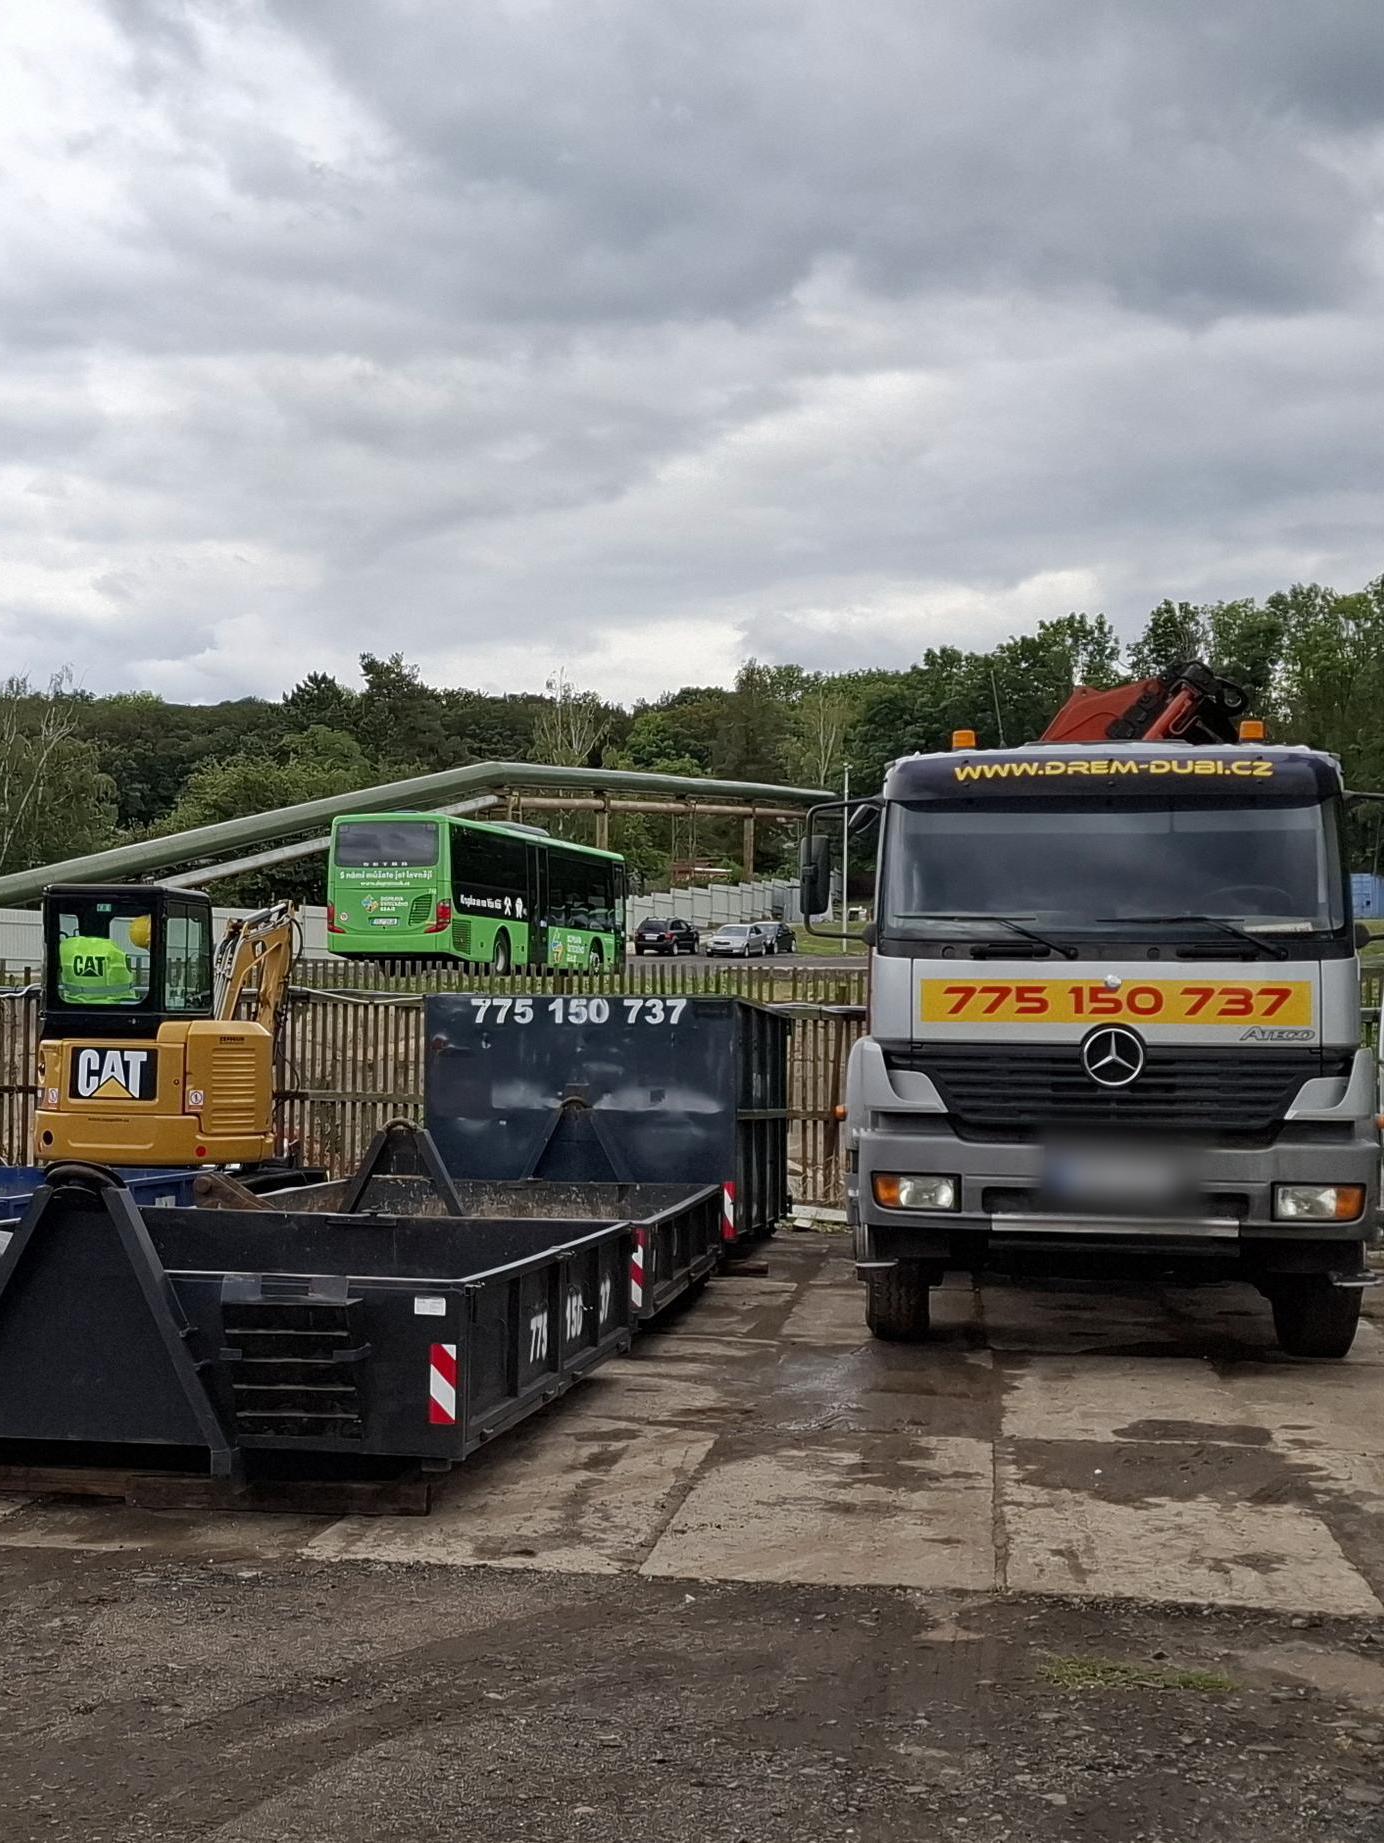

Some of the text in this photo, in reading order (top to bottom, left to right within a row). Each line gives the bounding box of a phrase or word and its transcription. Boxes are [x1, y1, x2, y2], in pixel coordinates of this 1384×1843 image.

[954, 760, 1274, 781] WWW.DREM-DUBI.CZ
[73, 955, 105, 977] CAT
[471, 998, 688, 1024] 775 150 737
[943, 986, 1293, 1017] 775 150 737
[77, 1048, 148, 1098] CAT
